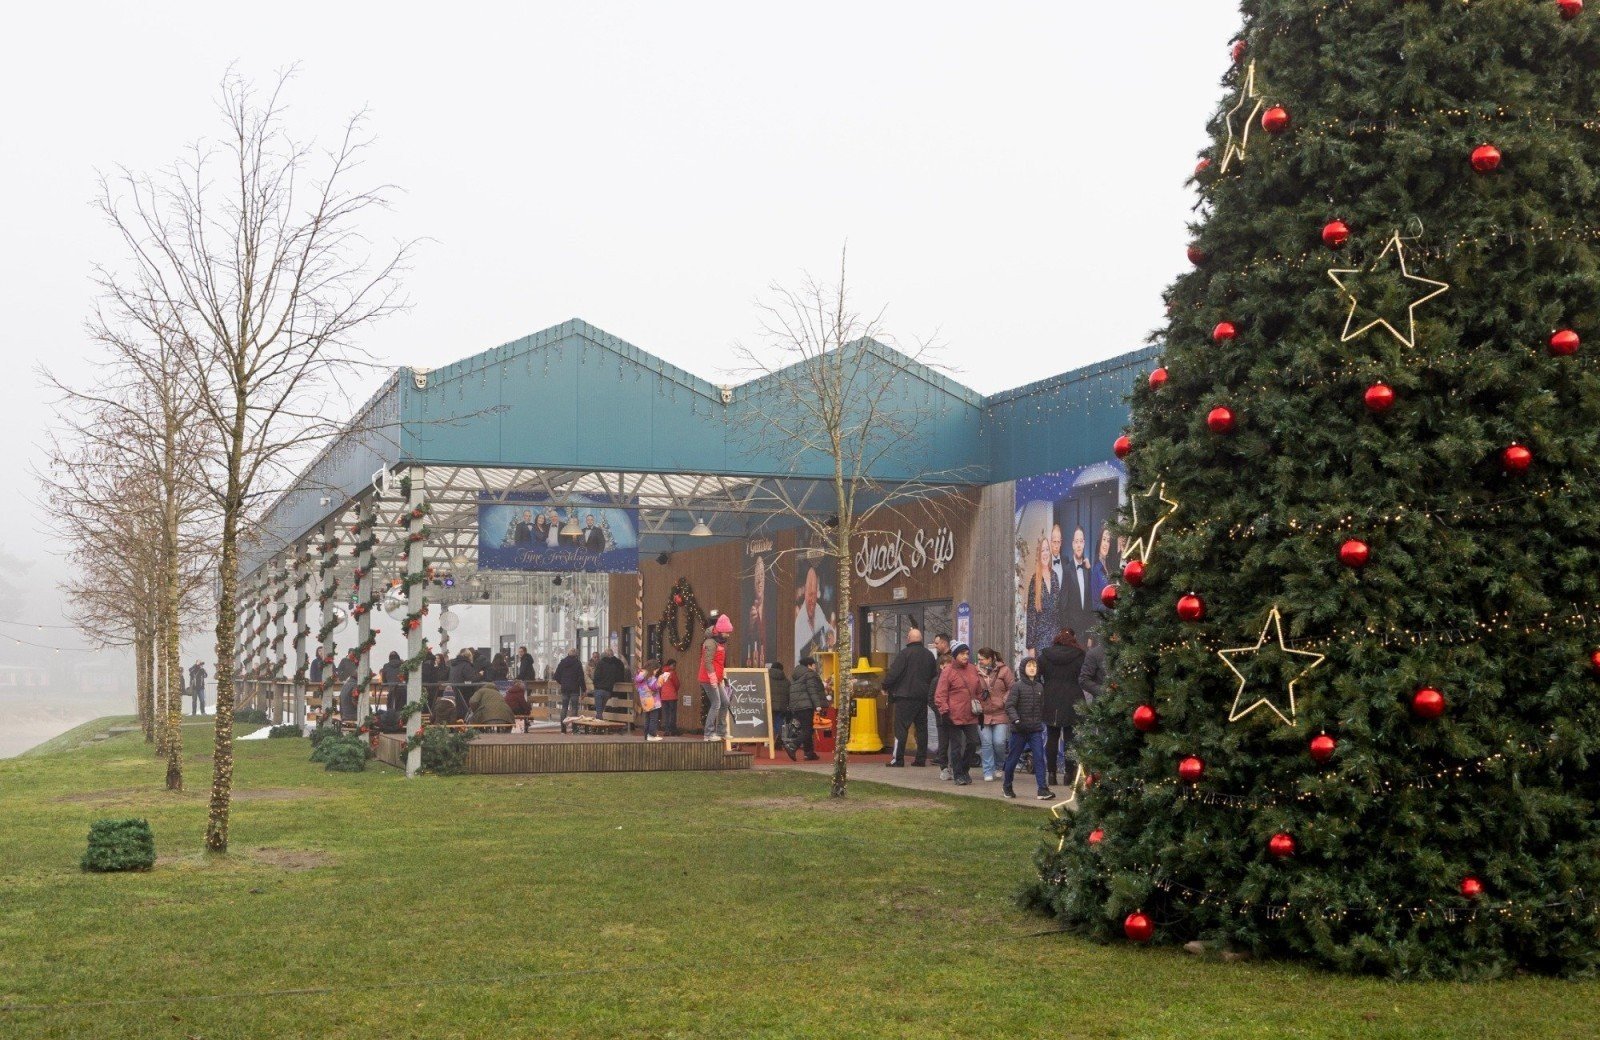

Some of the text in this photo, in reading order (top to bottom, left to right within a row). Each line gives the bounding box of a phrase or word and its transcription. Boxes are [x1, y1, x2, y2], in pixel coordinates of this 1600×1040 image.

[855, 529, 910, 587] Snack
[932, 527, 954, 573] ijs
[728, 678, 756, 692] Kaart
